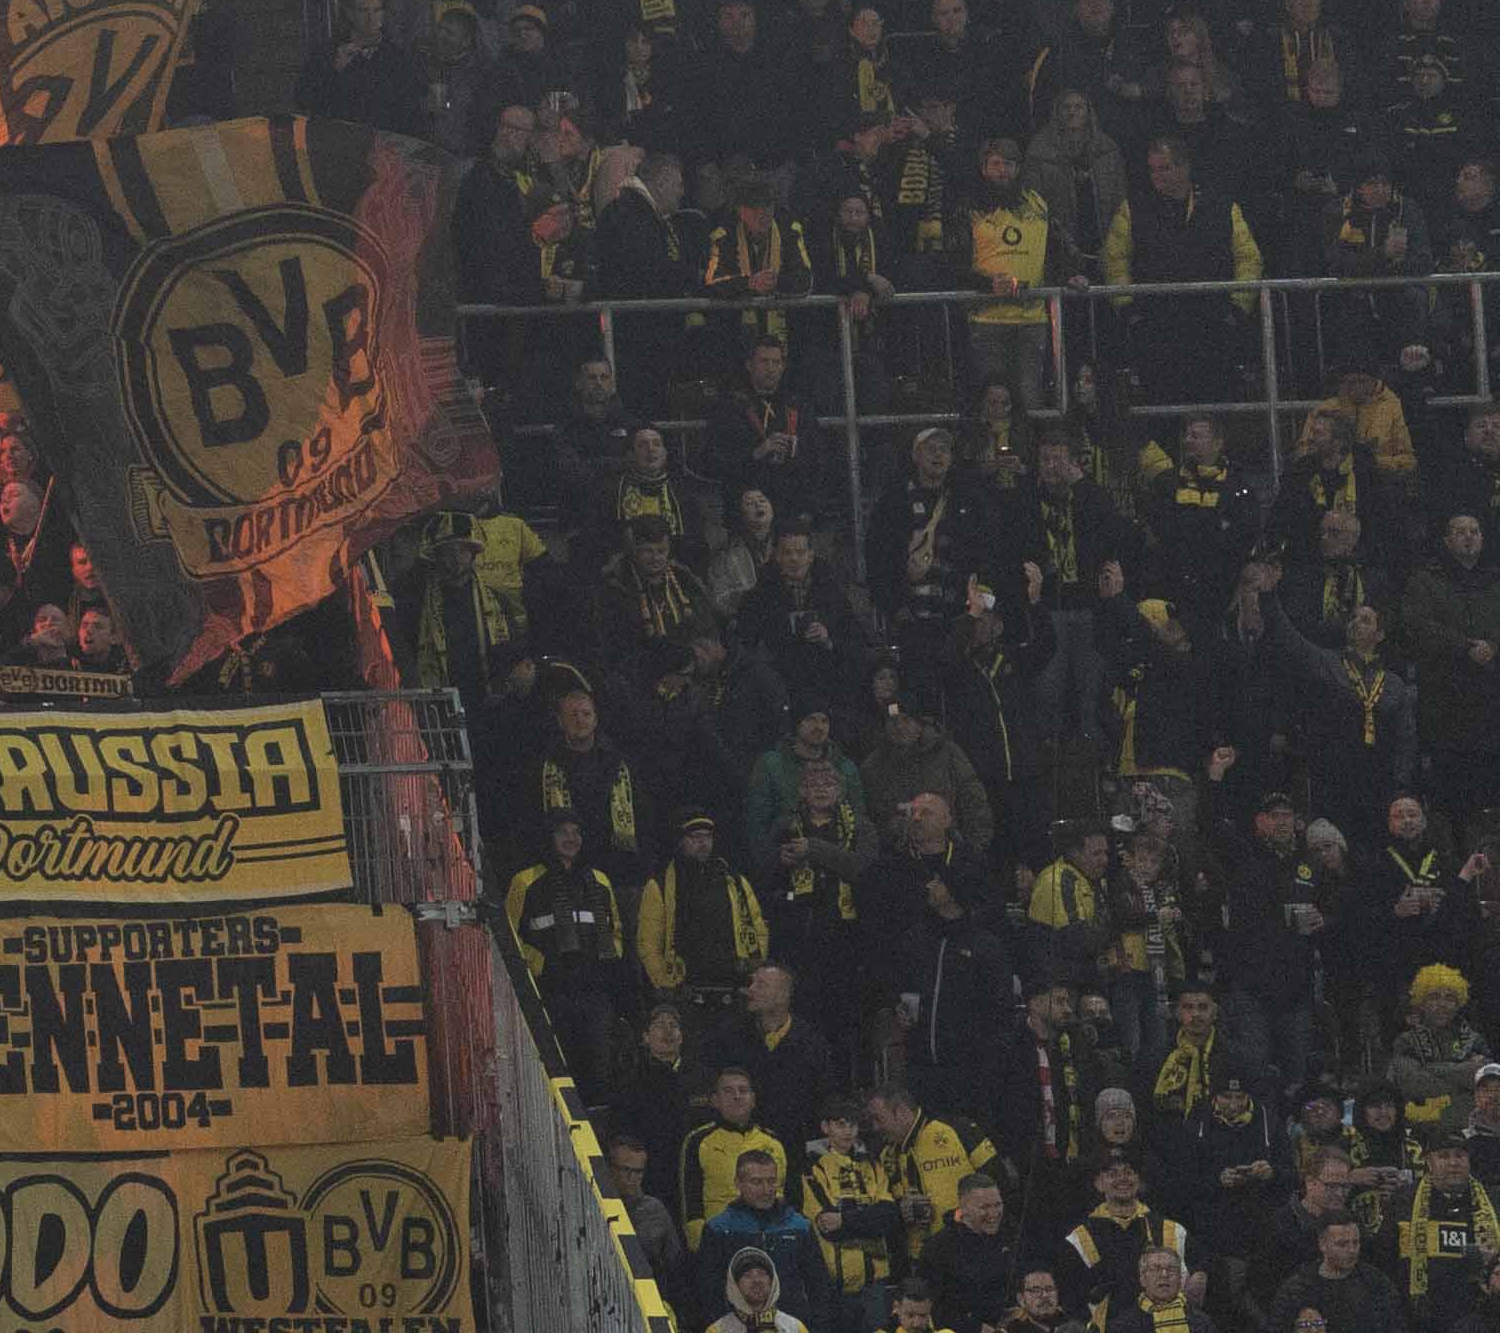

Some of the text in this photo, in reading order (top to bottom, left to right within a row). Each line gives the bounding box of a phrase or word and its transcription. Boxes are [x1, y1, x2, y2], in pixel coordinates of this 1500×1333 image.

[167, 256, 376, 449] BVB
[275, 426, 334, 483] 09
[208, 437, 378, 563] DORTMUND
[40, 672, 130, 697] DORTMU
[23, 917, 280, 964] SUPPORTERS
[112, 1093, 209, 1131] 2004
[323, 1190, 437, 1280] BVB
[1440, 1230, 1468, 1248] 1&1
[358, 1284, 397, 1309] 09
